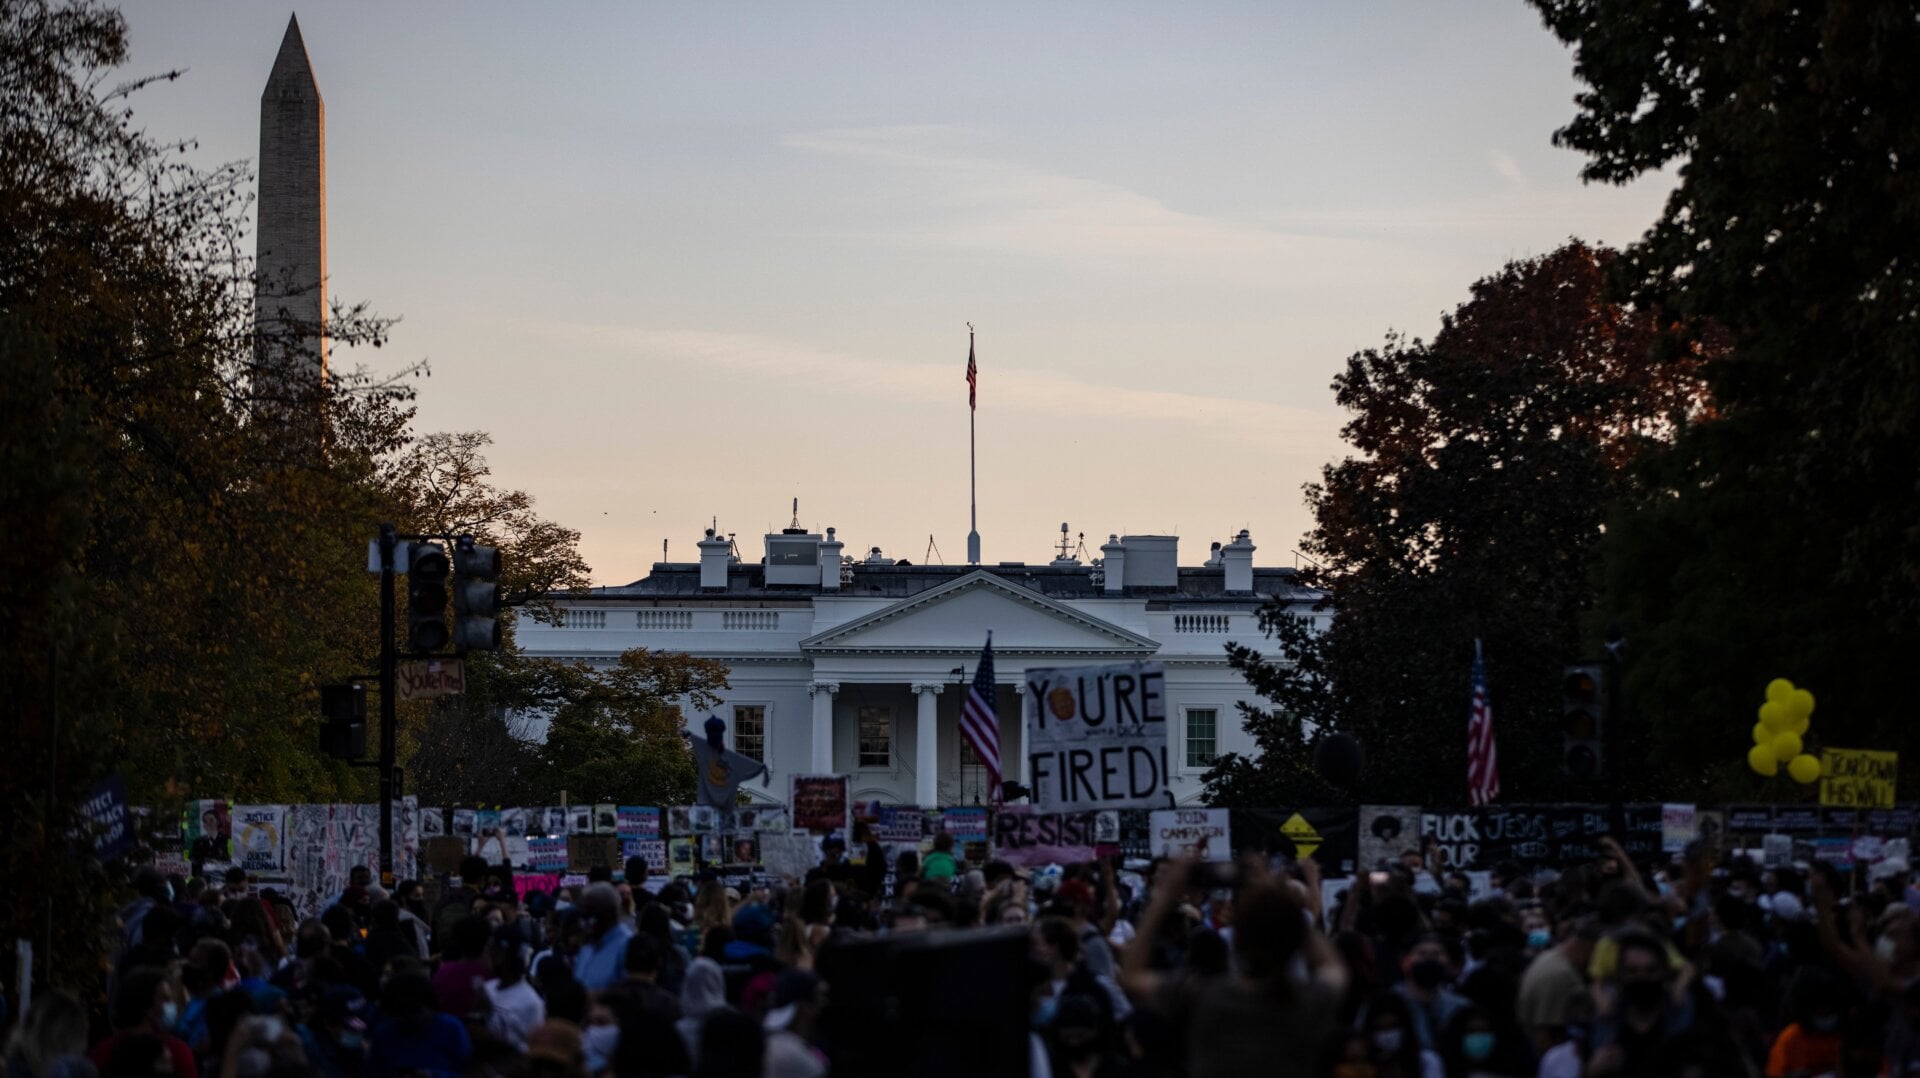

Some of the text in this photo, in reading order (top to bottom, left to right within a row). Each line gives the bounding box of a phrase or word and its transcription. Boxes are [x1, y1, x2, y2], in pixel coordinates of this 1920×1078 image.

[1030, 746, 1170, 803] FIRED!
[245, 812, 275, 823] JUSTICE
[1176, 811, 1208, 825] JOIN
[995, 813, 1091, 849] RESIST
[1160, 826, 1224, 840] CAMPAIGN
[1420, 814, 1481, 841] FUCK
[241, 860, 278, 870] BREONNA
